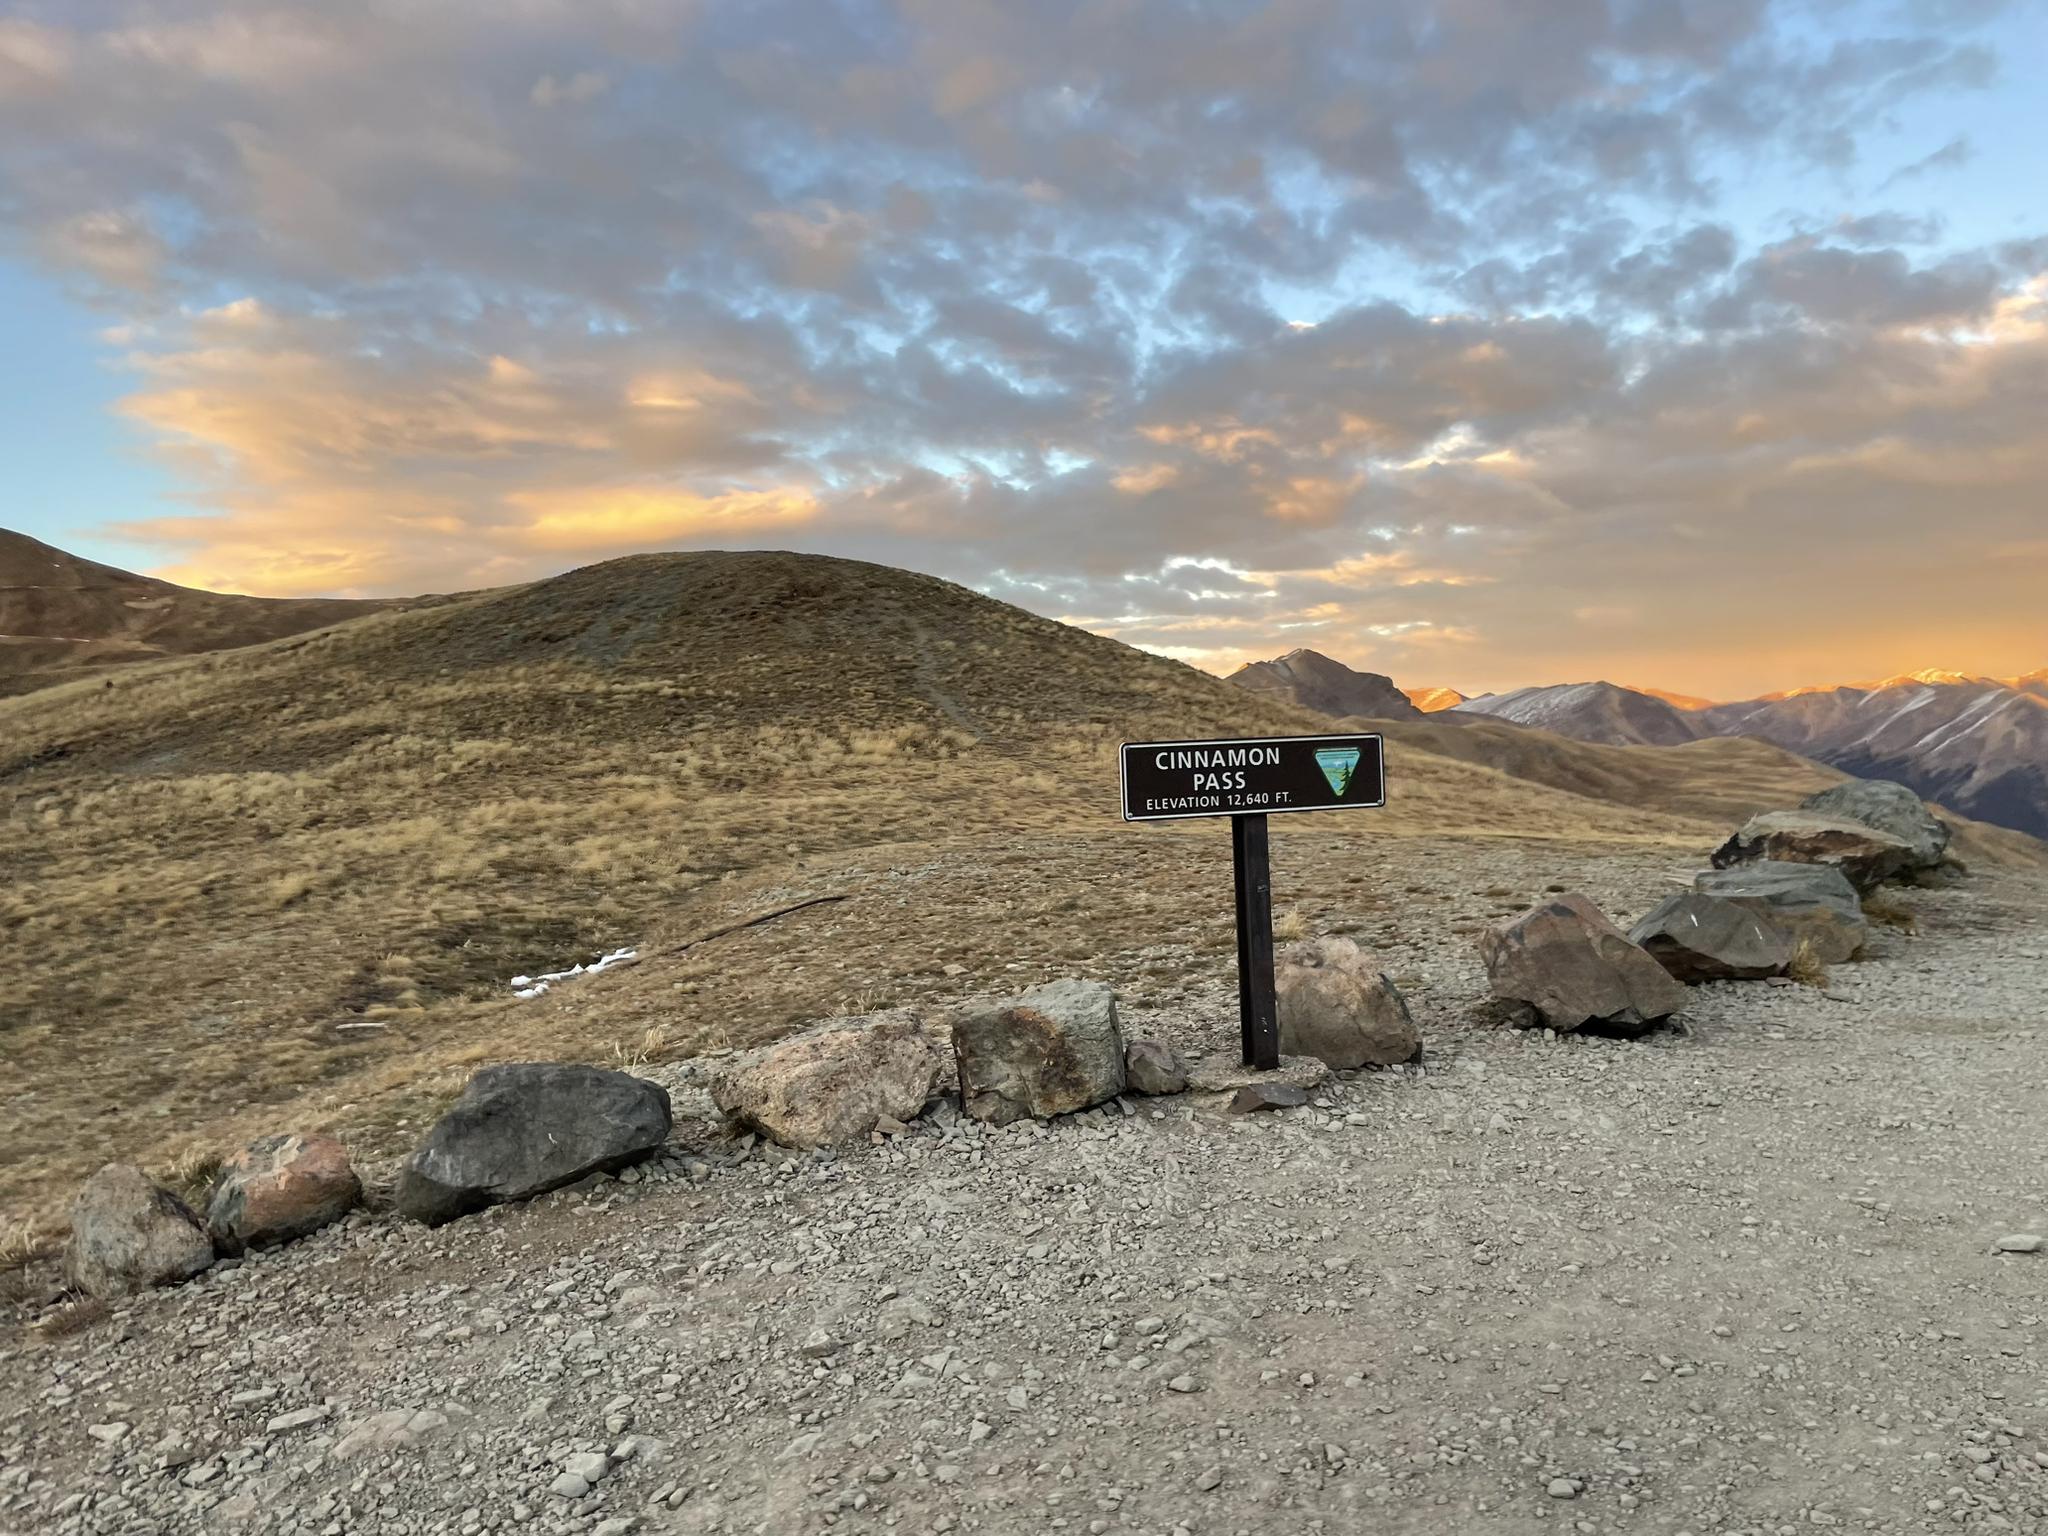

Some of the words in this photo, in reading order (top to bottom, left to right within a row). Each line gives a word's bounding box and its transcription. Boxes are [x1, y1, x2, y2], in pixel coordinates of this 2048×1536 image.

[1155, 747, 1280, 770] CINNAMON
[1193, 771, 1246, 791] PASS
[1146, 795, 1220, 811] ELEVATION
[1227, 792, 1269, 807] 12,640
[1275, 791, 1292, 804] FT.
